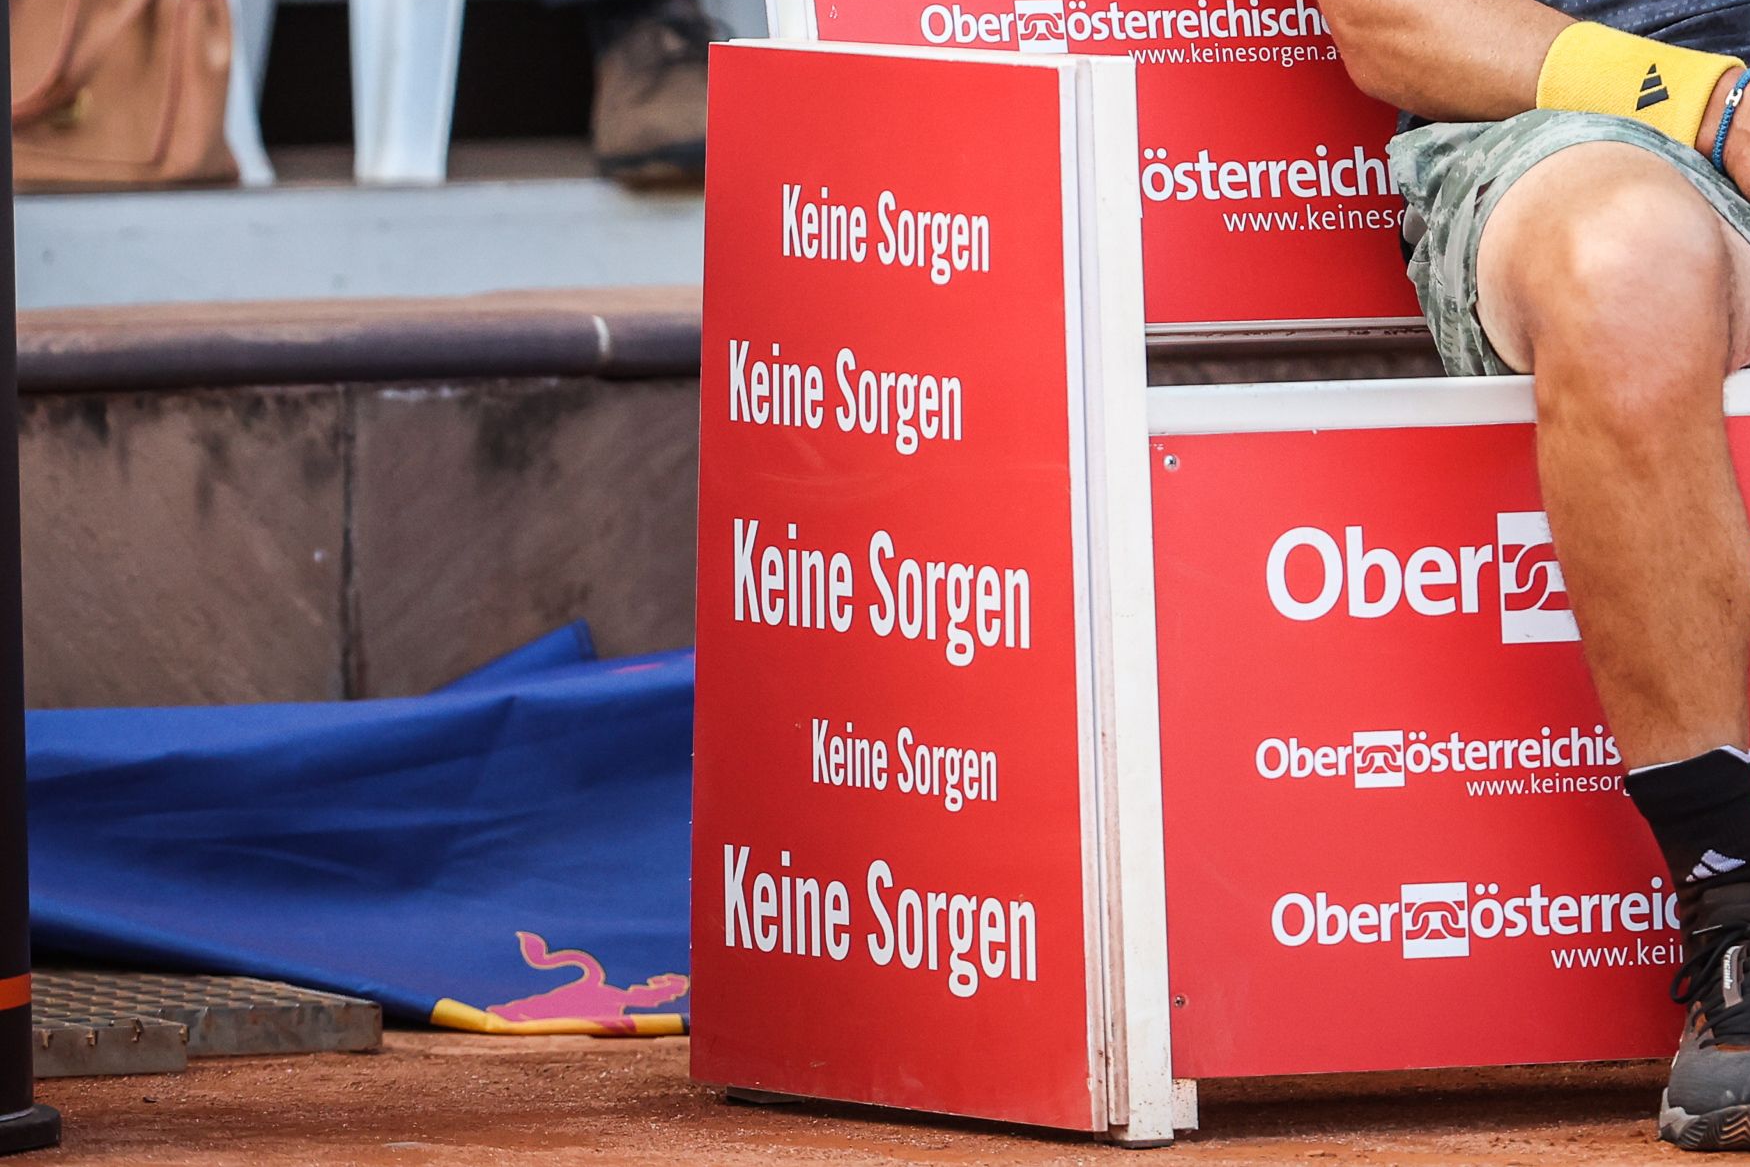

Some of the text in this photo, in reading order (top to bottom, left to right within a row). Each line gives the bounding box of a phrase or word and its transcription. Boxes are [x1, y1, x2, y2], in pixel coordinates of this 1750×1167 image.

[920, 3, 1015, 44] Ober
[1128, 42, 1343, 68] www.keinesorgen.a
[1142, 145, 1402, 202] österreichi
[782, 184, 990, 285] Keine Sorgen
[729, 340, 962, 455] Keine Sorgen
[733, 518, 1031, 667] Keine Sorgen
[1265, 525, 1494, 622] Ober
[811, 718, 998, 813] Keine Sorgen
[1255, 724, 1622, 780] Ober österreichis
[723, 843, 1038, 998] Keine Sorgen
[1271, 892, 1399, 947] Ober
